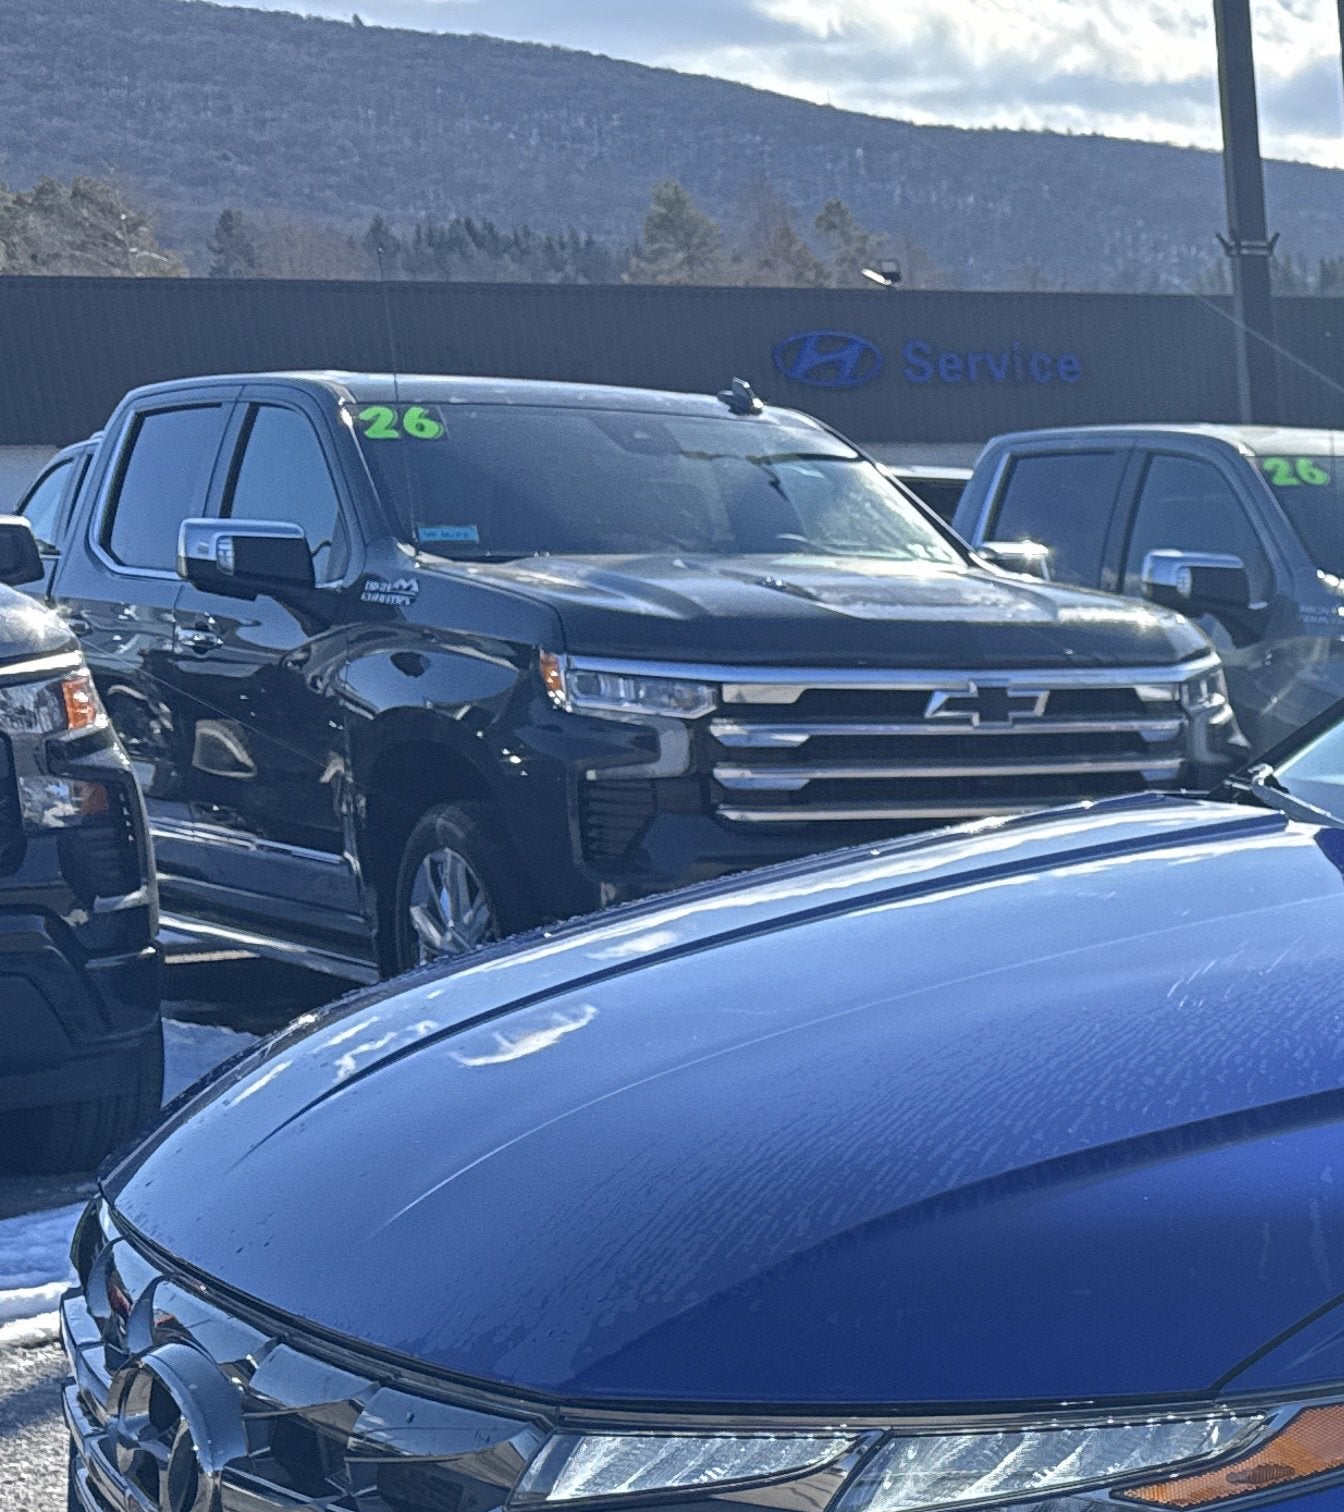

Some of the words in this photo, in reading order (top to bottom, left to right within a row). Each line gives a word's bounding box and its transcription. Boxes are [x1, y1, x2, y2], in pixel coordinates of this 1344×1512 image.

[903, 338, 1082, 384] Service
[359, 406, 444, 439] 26
[1263, 457, 1330, 486] 26
